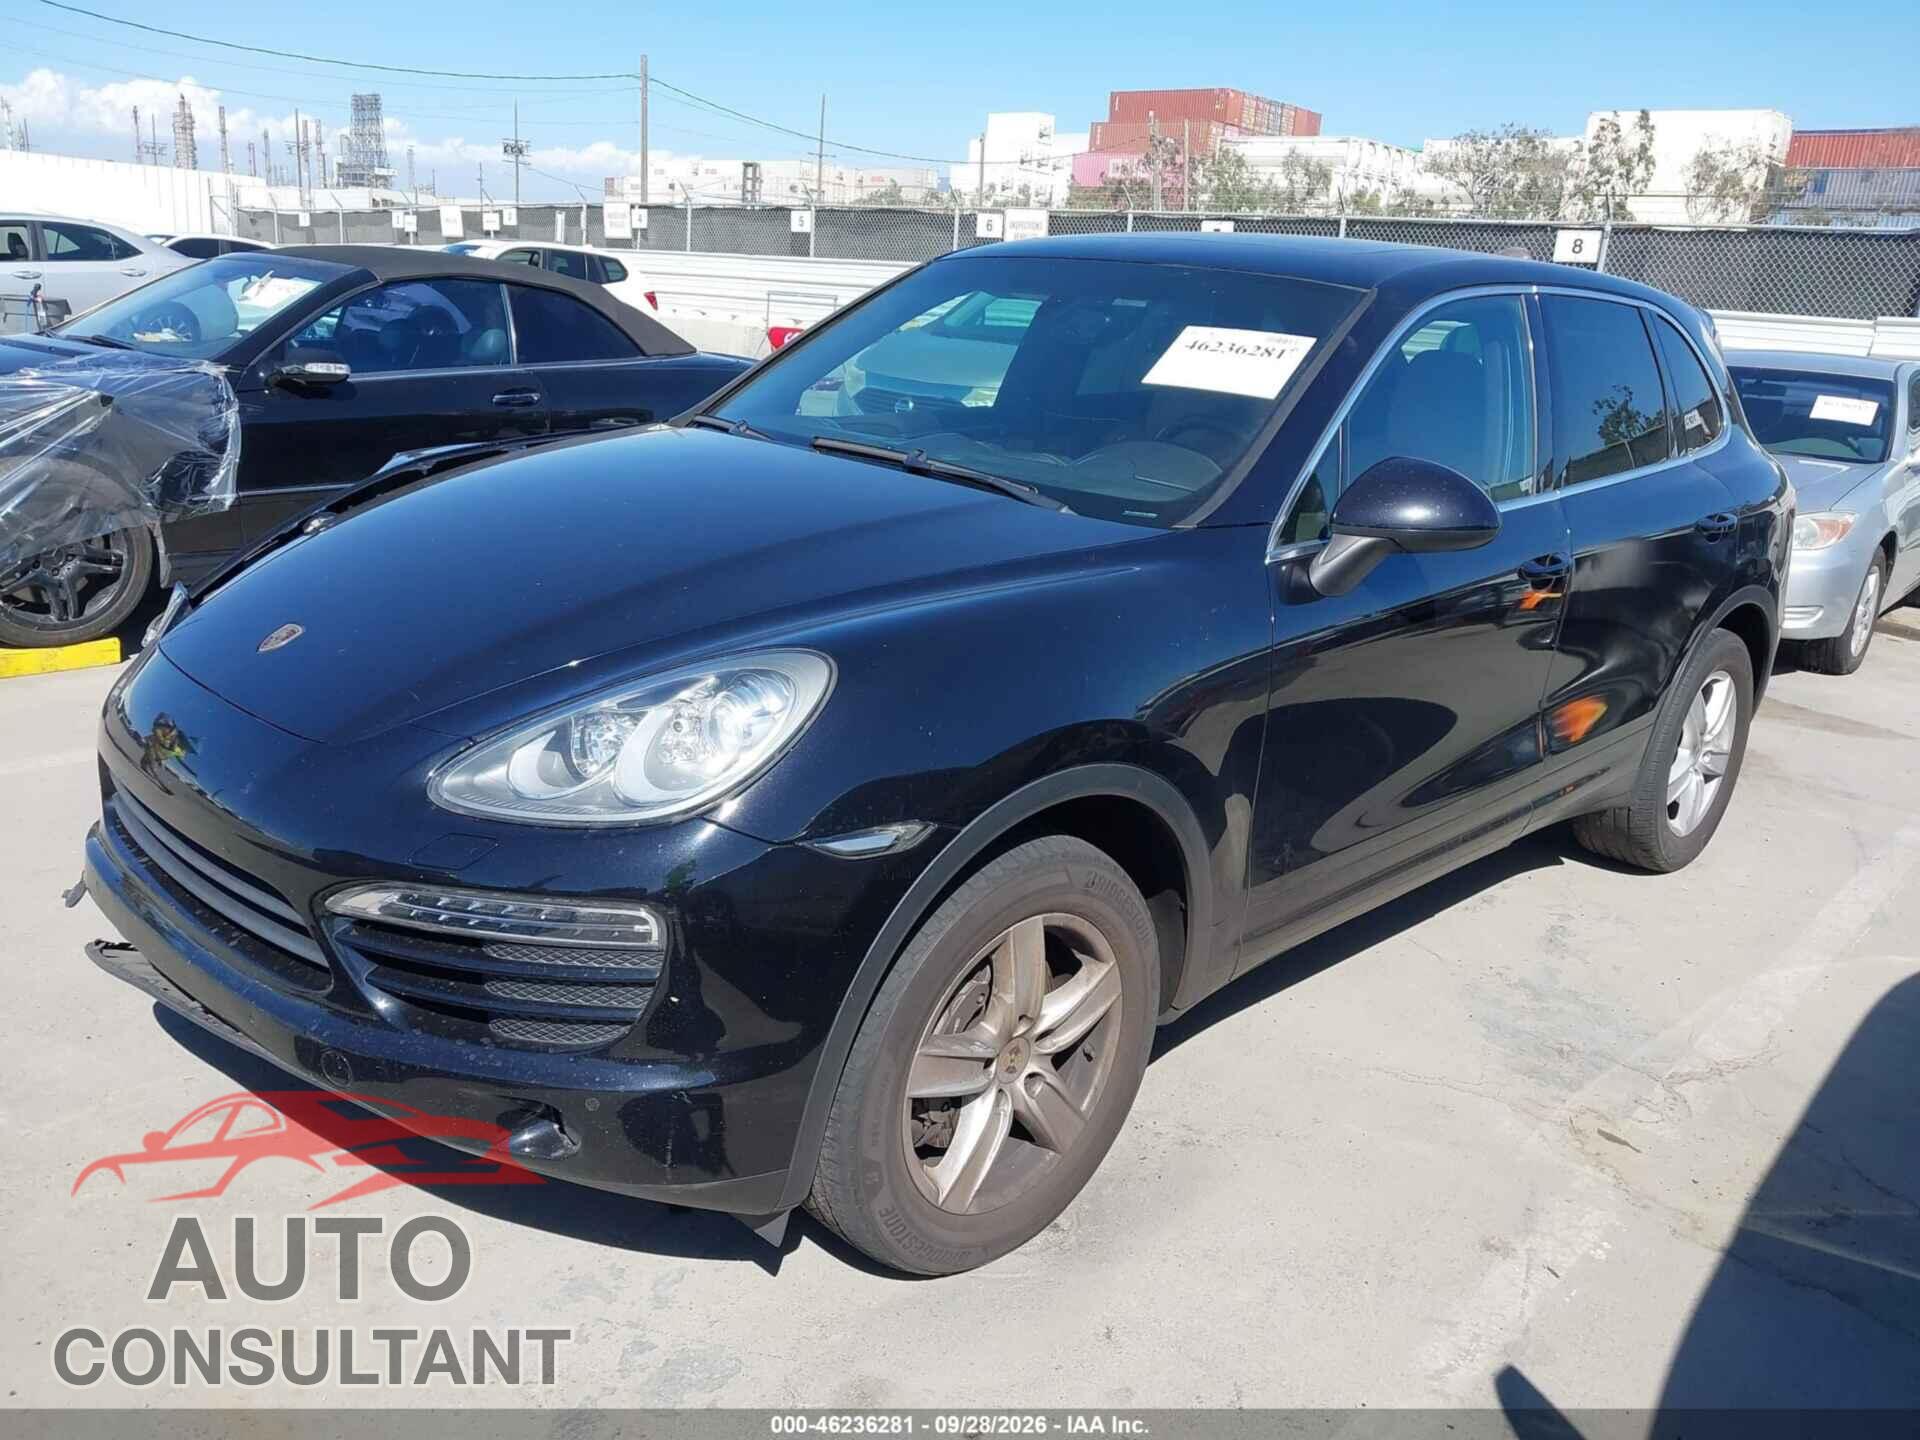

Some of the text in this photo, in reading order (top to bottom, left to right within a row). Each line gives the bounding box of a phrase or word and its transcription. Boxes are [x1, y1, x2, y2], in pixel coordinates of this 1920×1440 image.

[798, 215, 805, 227] 5
[986, 219, 993, 232] 6
[1571, 238, 1584, 254] 8
[1185, 339, 1285, 359] 46236281
